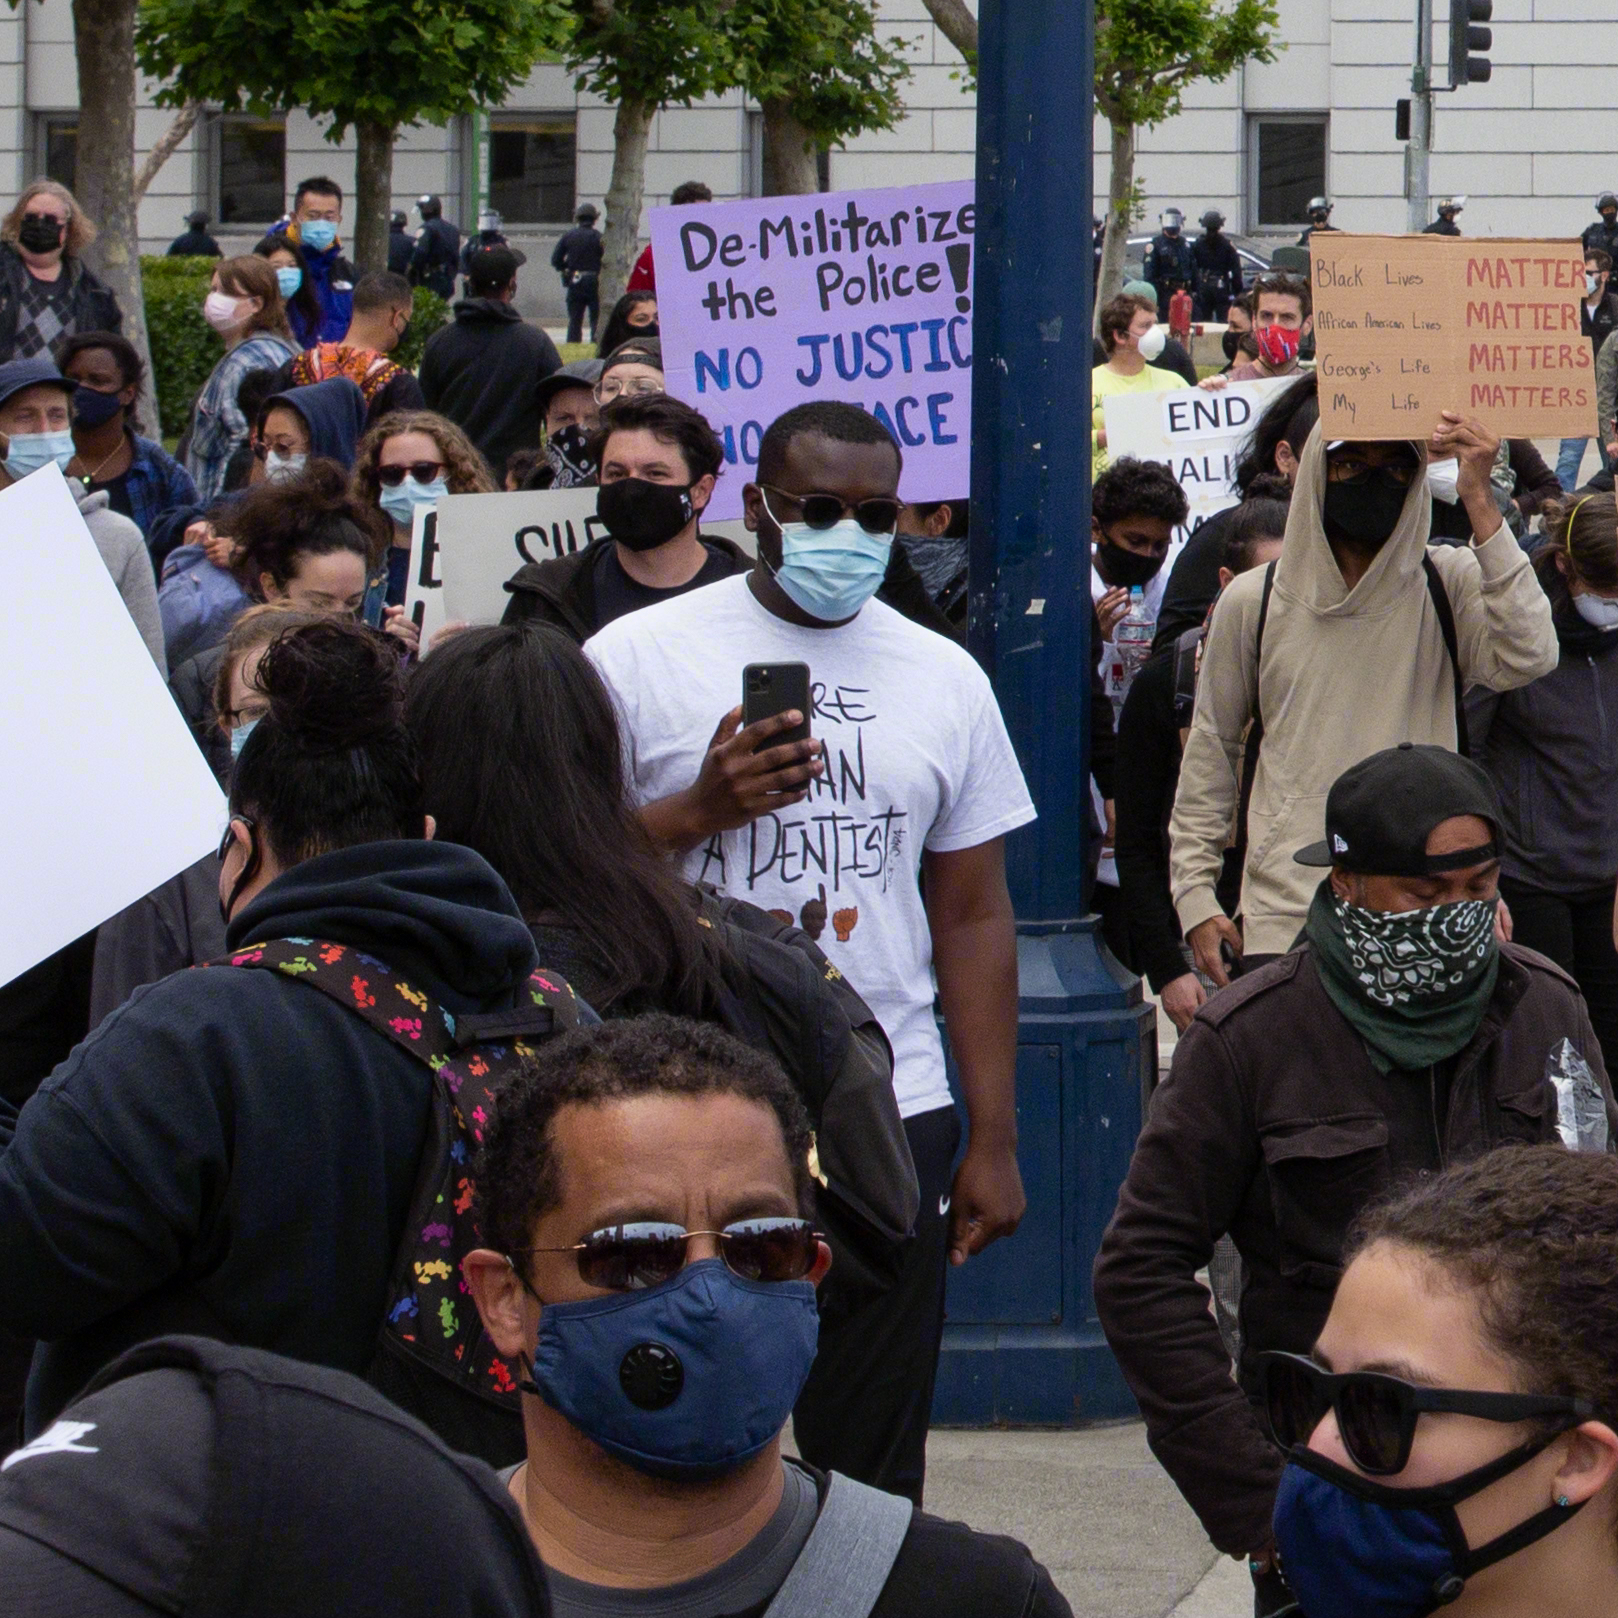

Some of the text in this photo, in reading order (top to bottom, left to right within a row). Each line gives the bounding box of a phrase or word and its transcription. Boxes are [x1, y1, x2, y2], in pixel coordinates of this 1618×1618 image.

[679, 201, 977, 273] De-Militarize
[701, 243, 972, 321] the Police!
[1317, 257, 1587, 290] Black Lives MATTER
[1318, 310, 1359, 329] African
[1364, 311, 1405, 329] American
[1412, 312, 1442, 331] Lives
[1466, 301, 1582, 332] MATTER
[694, 315, 973, 393] NO JUSTIC
[1322, 343, 1591, 380] George's Life MATTERS
[1168, 395, 1252, 433] END
[1332, 383, 1588, 424] My Life MATTERS
[702, 828, 727, 884] A
[747, 805, 908, 895] DENTIST
